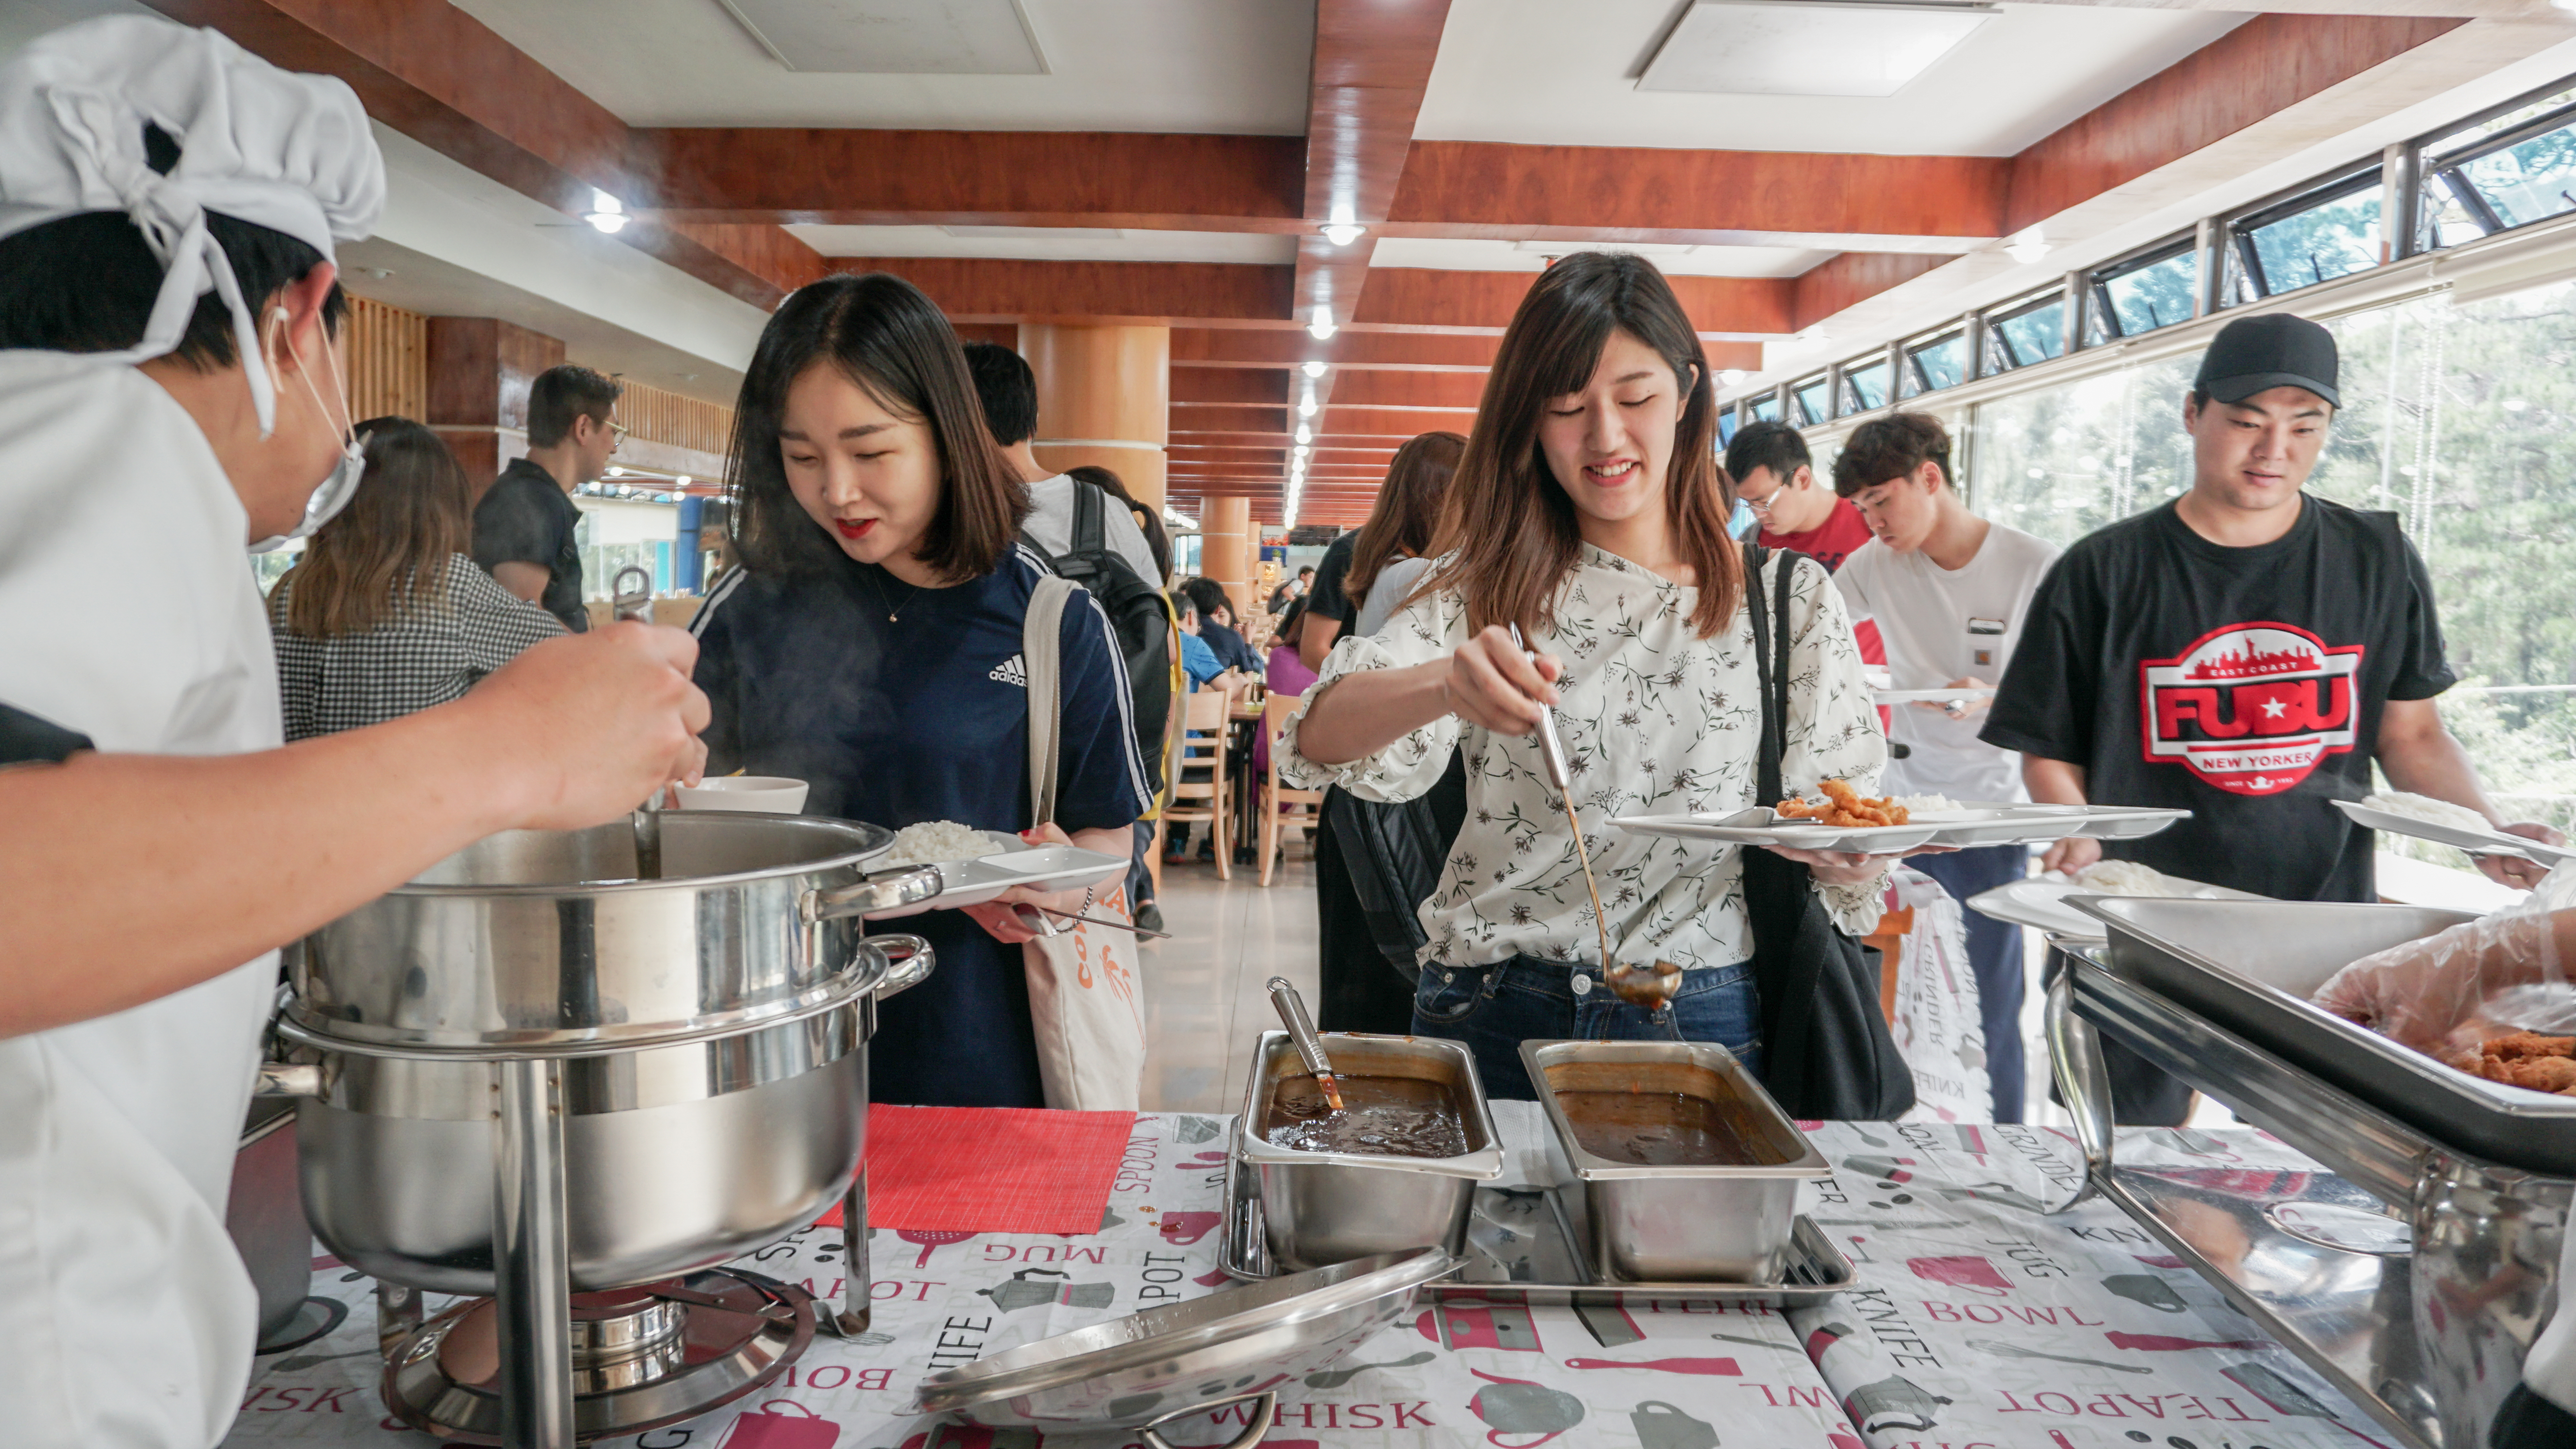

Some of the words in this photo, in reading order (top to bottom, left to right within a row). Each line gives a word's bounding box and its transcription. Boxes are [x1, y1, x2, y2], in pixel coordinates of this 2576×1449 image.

[2211, 668, 2245, 676] EAST
[2250, 662, 2297, 674] COAST
[2157, 676, 2349, 738] FUBU
[2203, 757, 2242, 769] NEW
[2247, 752, 2313, 767] YORKER
[1114, 1137, 1159, 1193] SPOON
[983, 1243, 1109, 1264] MUG
[1985, 1239, 2069, 1278] JUG
[1918, 1300, 2105, 1326] BOWL
[1844, 1288, 1944, 1369] KNIFE
[240, 1387, 368, 1413] ISK
[1996, 1389, 2270, 1423] TEAPOT
